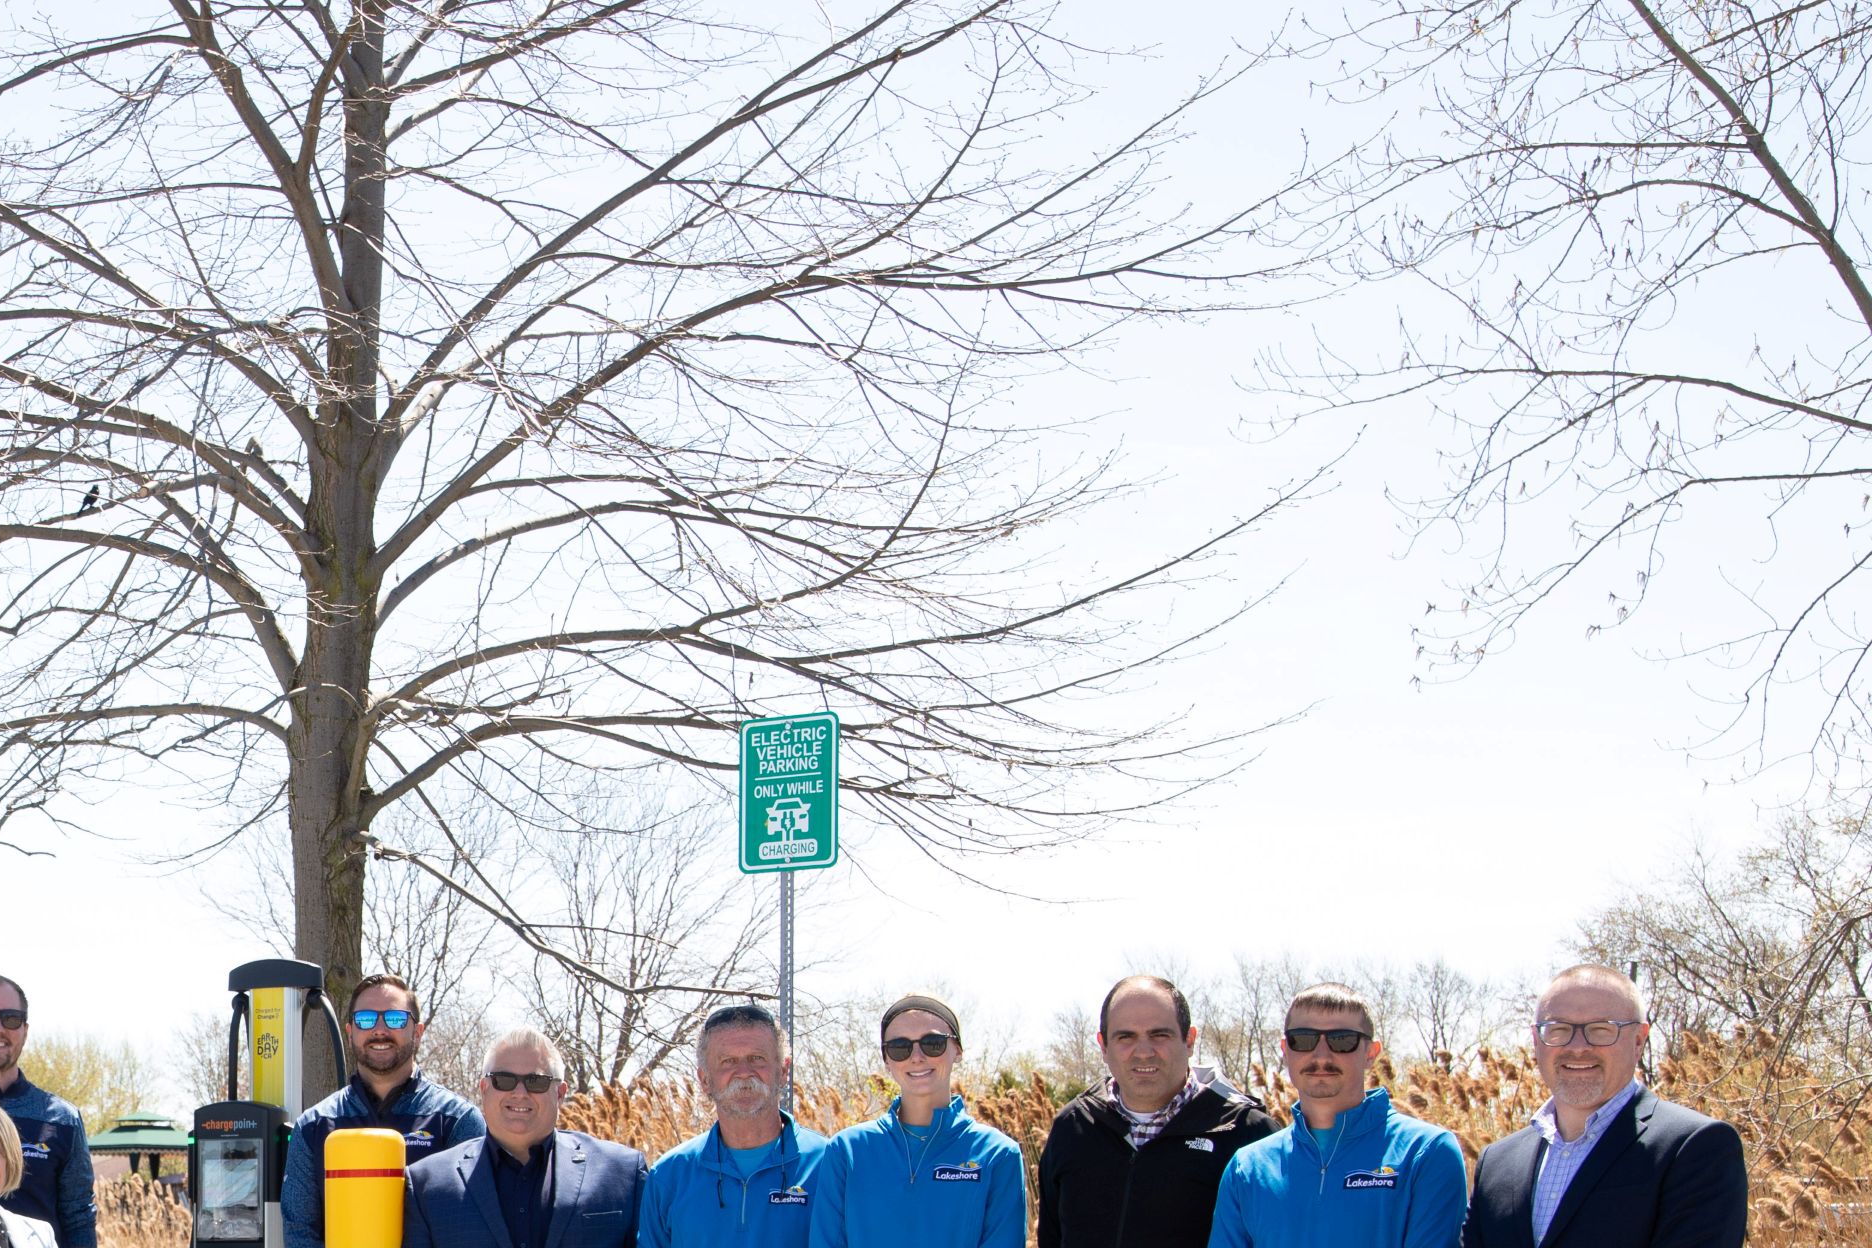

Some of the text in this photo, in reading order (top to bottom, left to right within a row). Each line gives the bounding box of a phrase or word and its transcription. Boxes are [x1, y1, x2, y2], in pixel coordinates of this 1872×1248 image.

[751, 726, 827, 747] ELECTRIC
[756, 741, 823, 760] VEHICLE
[759, 756, 819, 774] PARKING
[753, 779, 824, 798] ONLY WHILE
[761, 841, 815, 857] CHARGING
[257, 1032, 279, 1046] EARTH
[257, 1042, 279, 1056] DAY
[22, 1150, 48, 1160] akeshore
[935, 1170, 978, 1180] Lakeshore
[1346, 1178, 1394, 1187] Lakeshore
